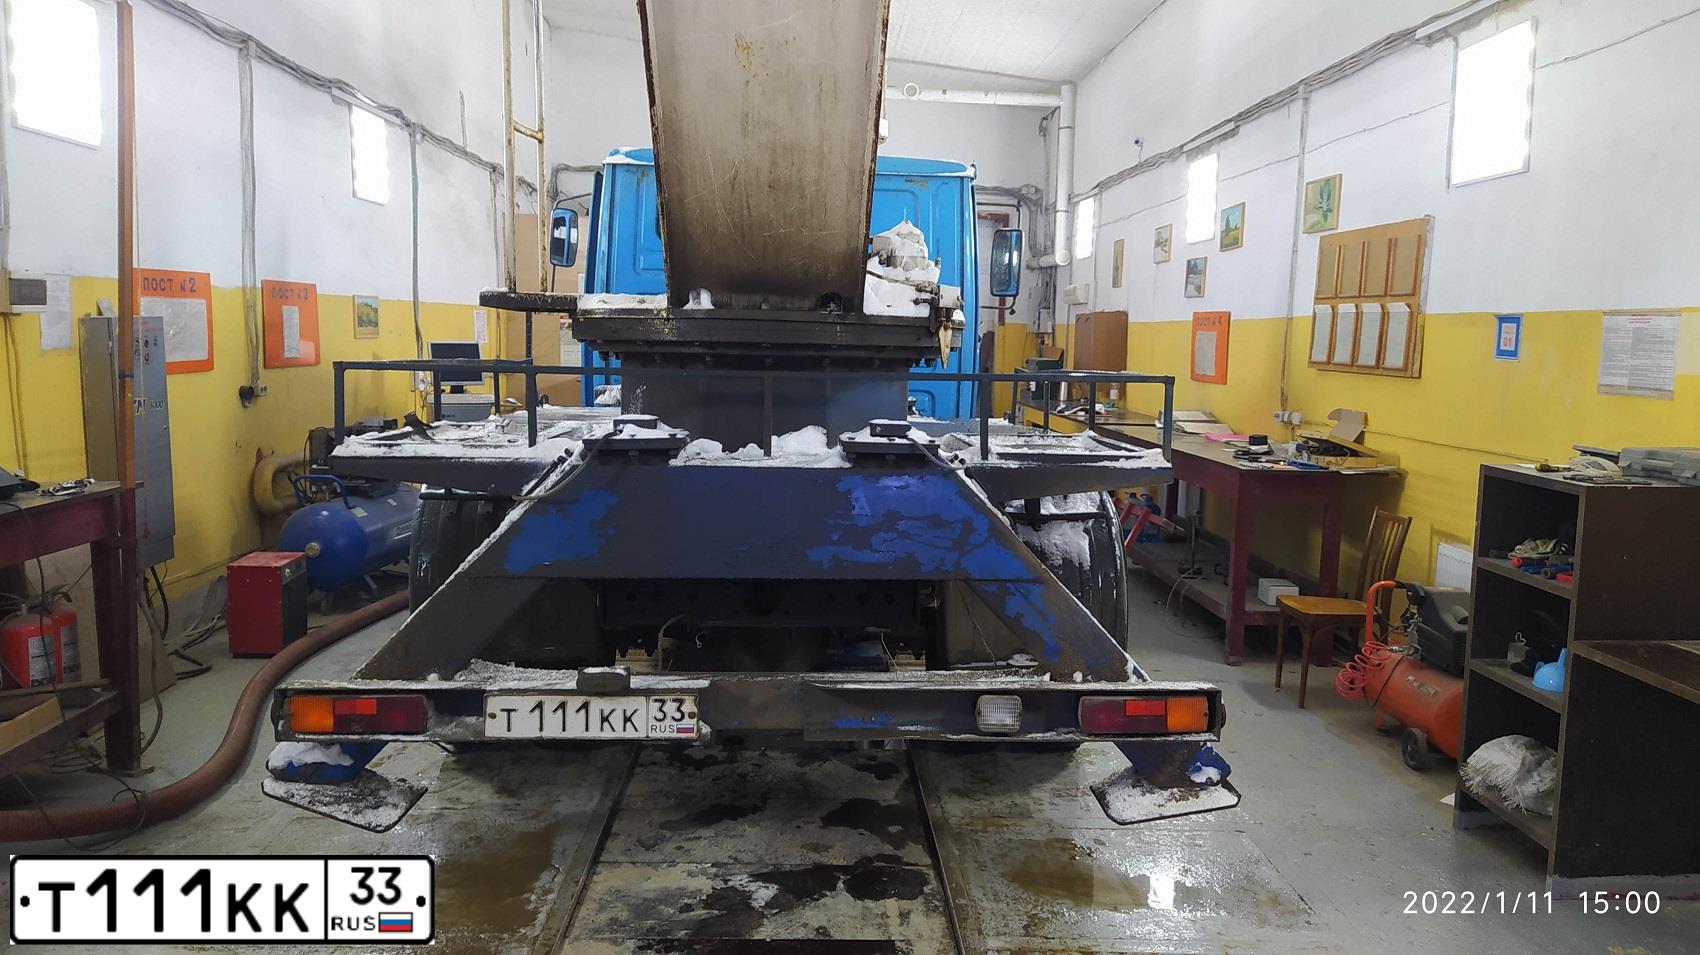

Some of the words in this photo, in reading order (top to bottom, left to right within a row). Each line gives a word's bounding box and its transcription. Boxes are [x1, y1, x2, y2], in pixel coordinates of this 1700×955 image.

[143, 276, 174, 292] ПОСТ
[652, 698, 685, 722] 33
[650, 724, 675, 734] RUS
